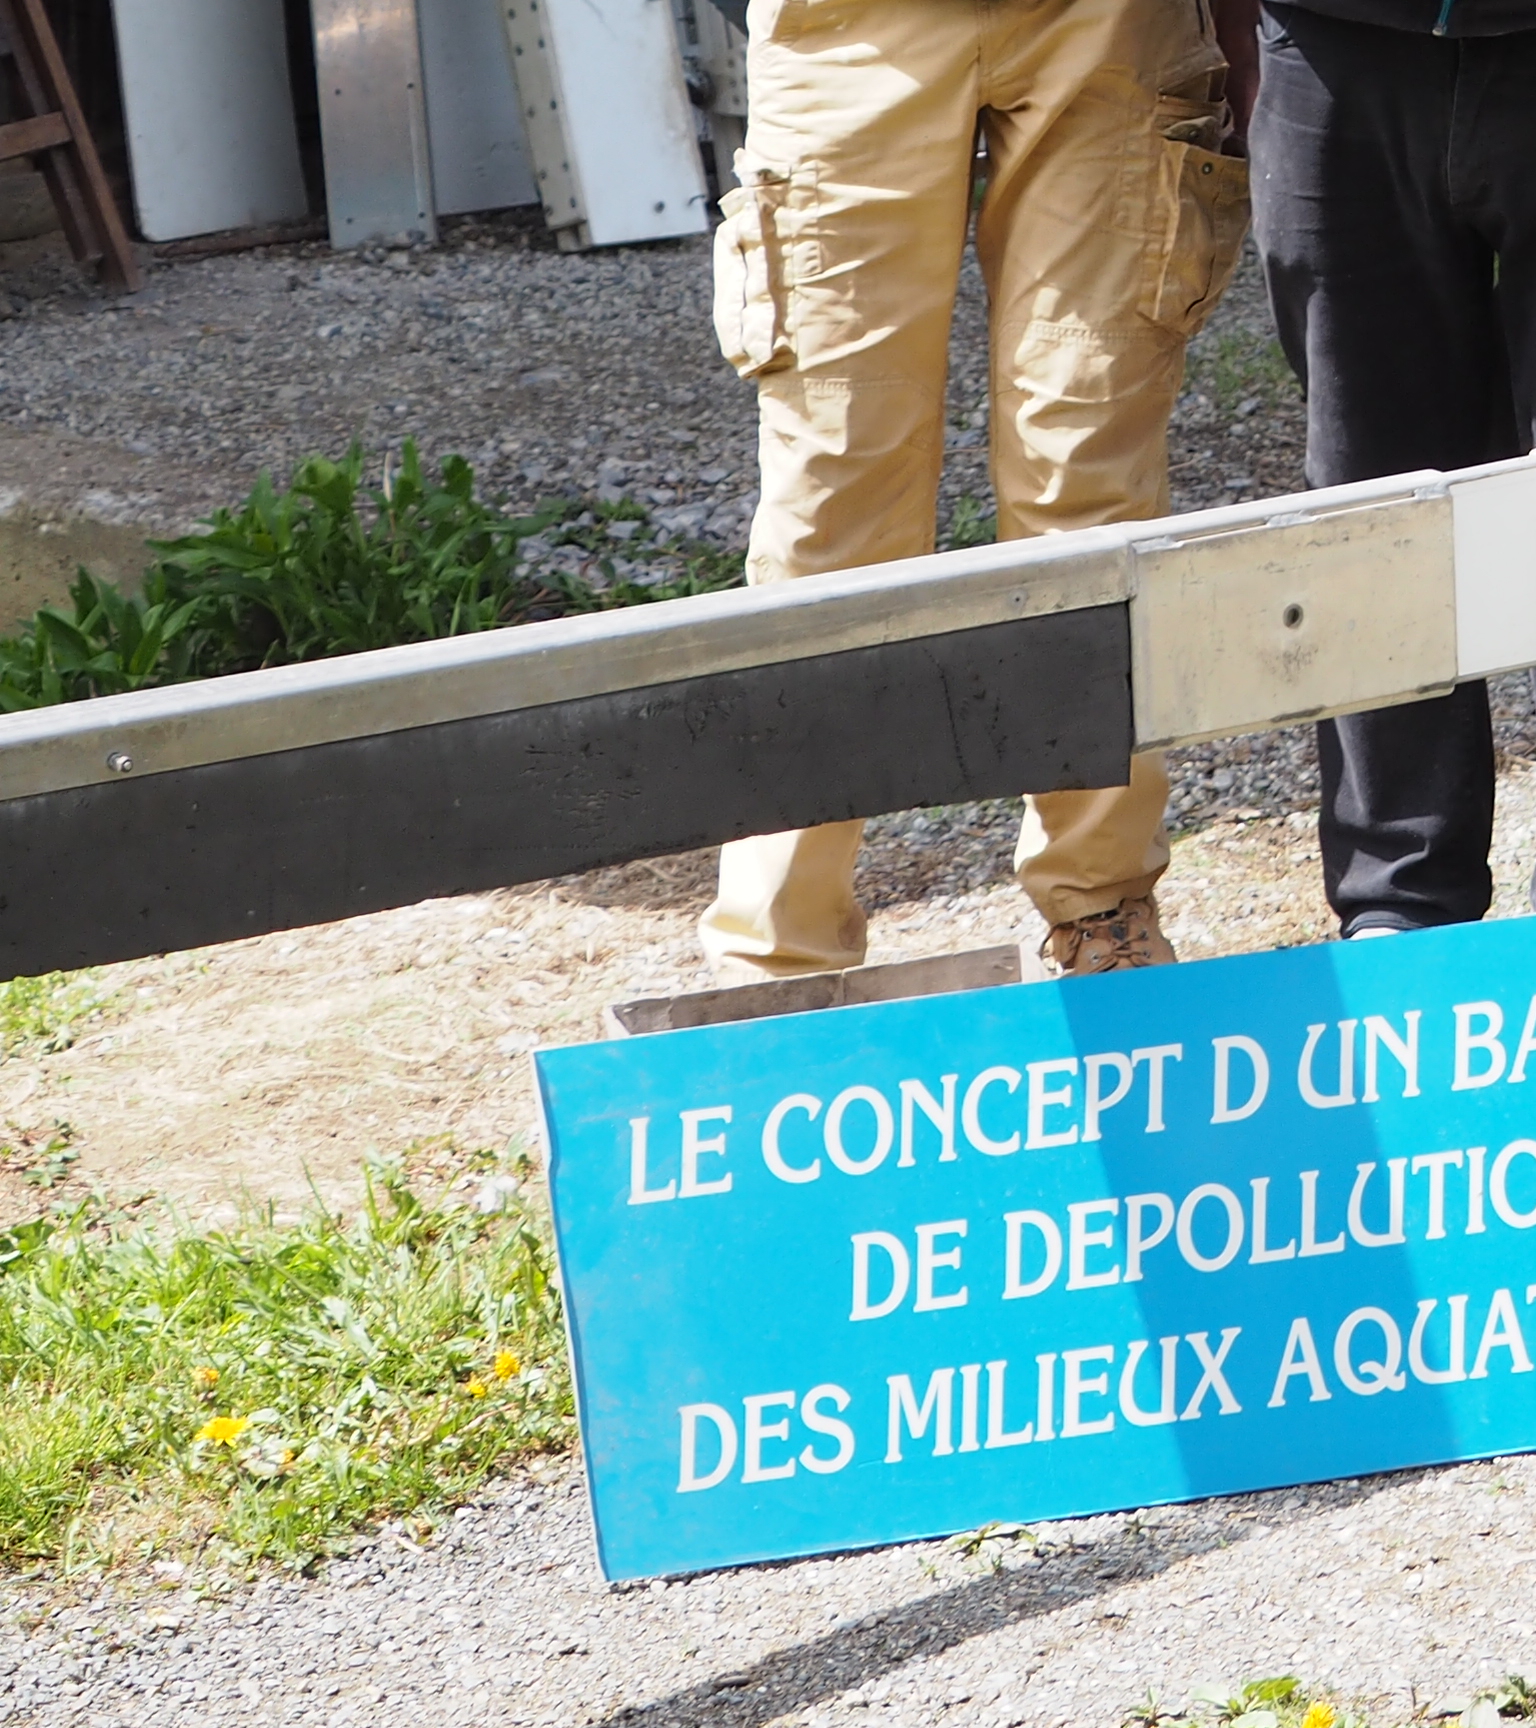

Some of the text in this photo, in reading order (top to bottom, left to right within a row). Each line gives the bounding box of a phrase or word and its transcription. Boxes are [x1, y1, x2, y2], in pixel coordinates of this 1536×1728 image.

[627, 1105, 733, 1205] LE
[762, 1044, 1182, 1183] CONCEPT
[1211, 1035, 1270, 1124] D
[1298, 1010, 1422, 1108] UN
[850, 1219, 968, 1321] DE
[676, 1384, 855, 1493] DES
[885, 1327, 1242, 1463] MILIEUX
